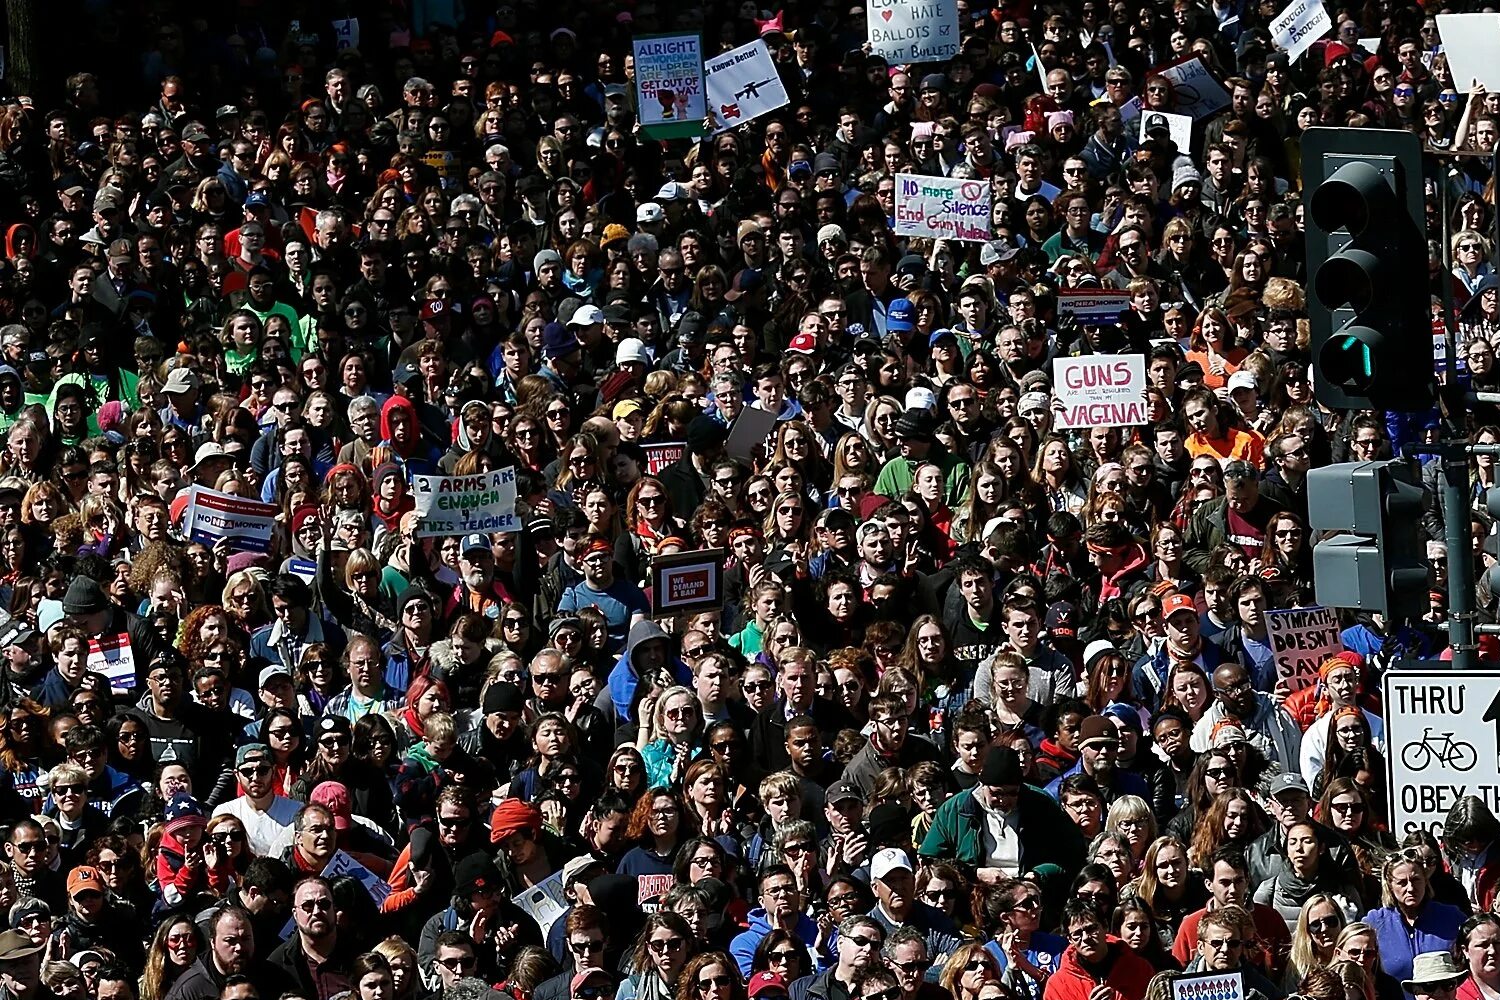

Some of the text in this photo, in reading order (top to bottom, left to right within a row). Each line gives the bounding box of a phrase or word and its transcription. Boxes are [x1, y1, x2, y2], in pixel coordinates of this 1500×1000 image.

[911, 3, 944, 20] HATE
[1274, 3, 1307, 35] ENOUGH
[873, 26, 931, 42] BALLOTS
[1288, 25, 1298, 35] IS
[1292, 11, 1326, 45] ENOUGH!
[712, 58, 735, 74] Knows
[734, 47, 759, 65] Better!
[878, 44, 958, 59] BEAT BULLETS
[640, 60, 698, 72] CHILDREN
[641, 71, 662, 79] ARE
[668, 69, 698, 78] HERE
[641, 77, 698, 90] GET OUT OF
[641, 89, 661, 99] TH
[903, 179, 954, 199] NO more
[897, 204, 954, 231] End Gun
[942, 200, 990, 217] Silence
[1066, 362, 1131, 389] GUNS
[1061, 402, 1146, 426] VAGINA!
[665, 449, 682, 460] COLD
[419, 468, 515, 493] 2 ARMS ARE
[438, 491, 500, 511] ENOUGH
[197, 513, 268, 531] NO NRA MONEY
[423, 514, 513, 532] THIS TEACHER
[462, 510, 470, 520] 4
[673, 581, 705, 592] DEMAND
[680, 589, 697, 598] BAN
[1275, 630, 1339, 653] DOESN'T
[1393, 684, 1465, 715] THRU
[1400, 785, 1477, 814] OBEY
